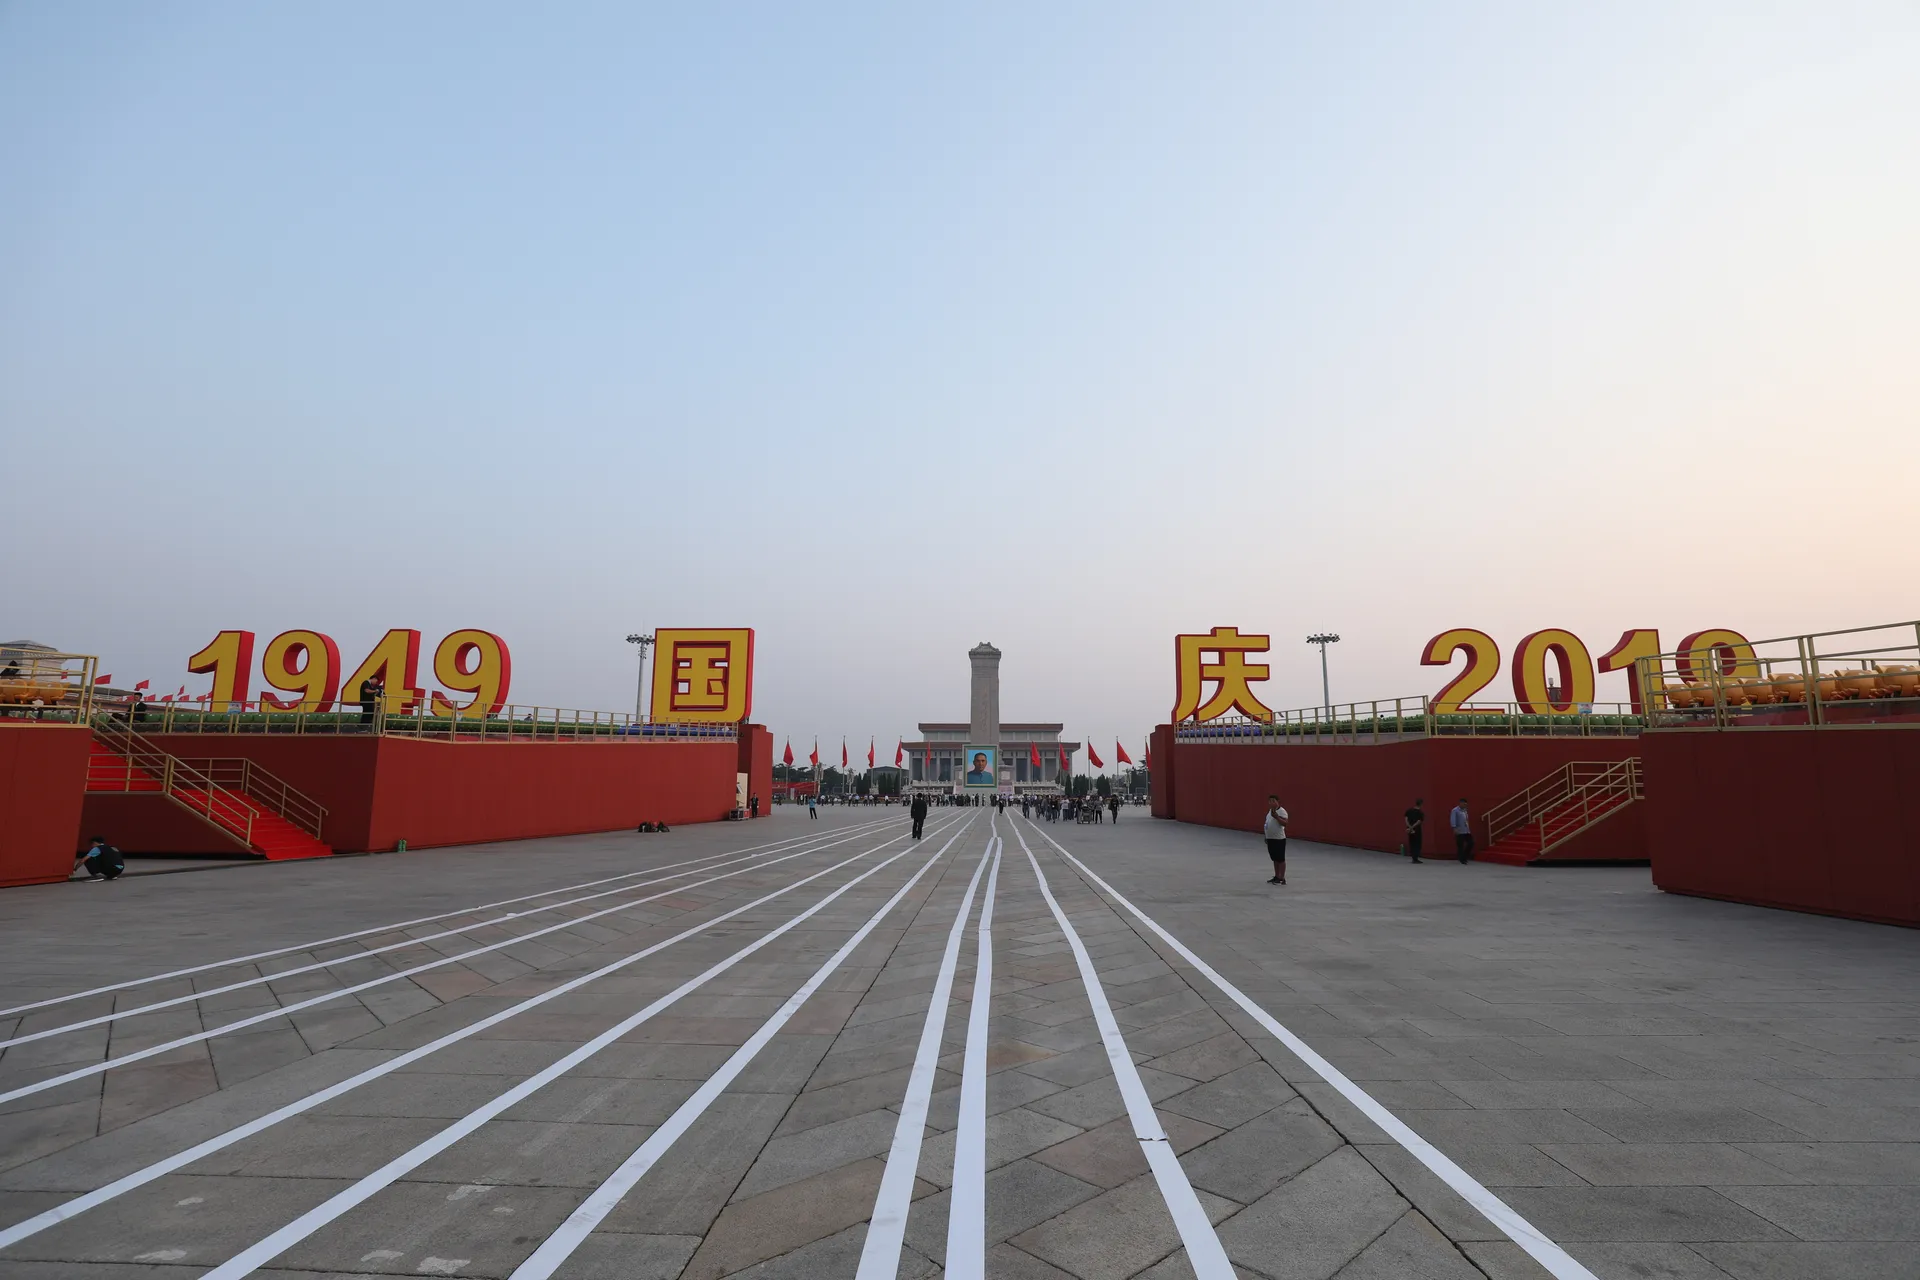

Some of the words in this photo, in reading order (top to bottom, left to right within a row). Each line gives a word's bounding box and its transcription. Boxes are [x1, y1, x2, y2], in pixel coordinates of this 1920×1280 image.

[187, 629, 511, 718] 1949
[650, 628, 754, 724] 国
[1171, 627, 1272, 724] 庆
[1420, 628, 1760, 716] 2019
